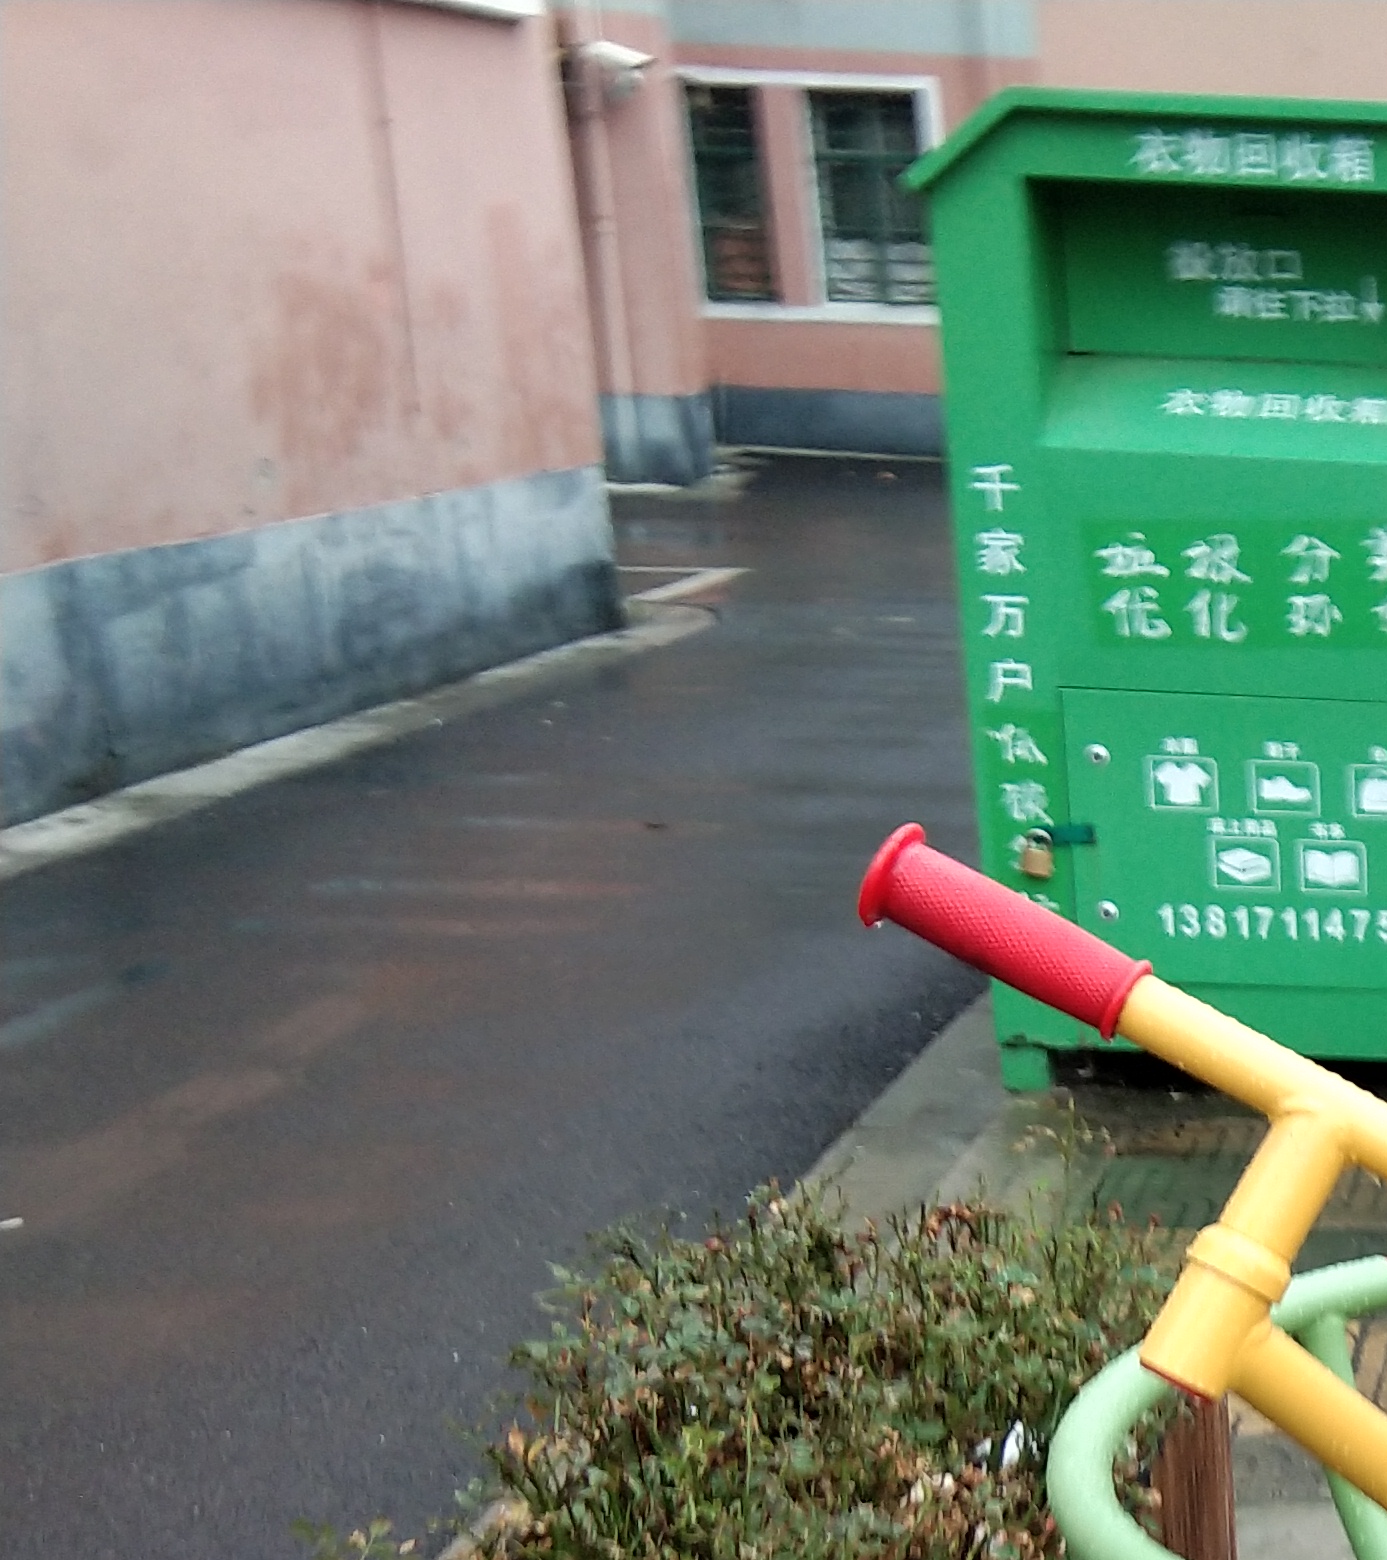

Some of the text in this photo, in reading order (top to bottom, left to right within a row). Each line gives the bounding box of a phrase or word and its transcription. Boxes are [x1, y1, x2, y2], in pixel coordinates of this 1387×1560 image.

[1126, 127, 1375, 183] 衣物回收箱
